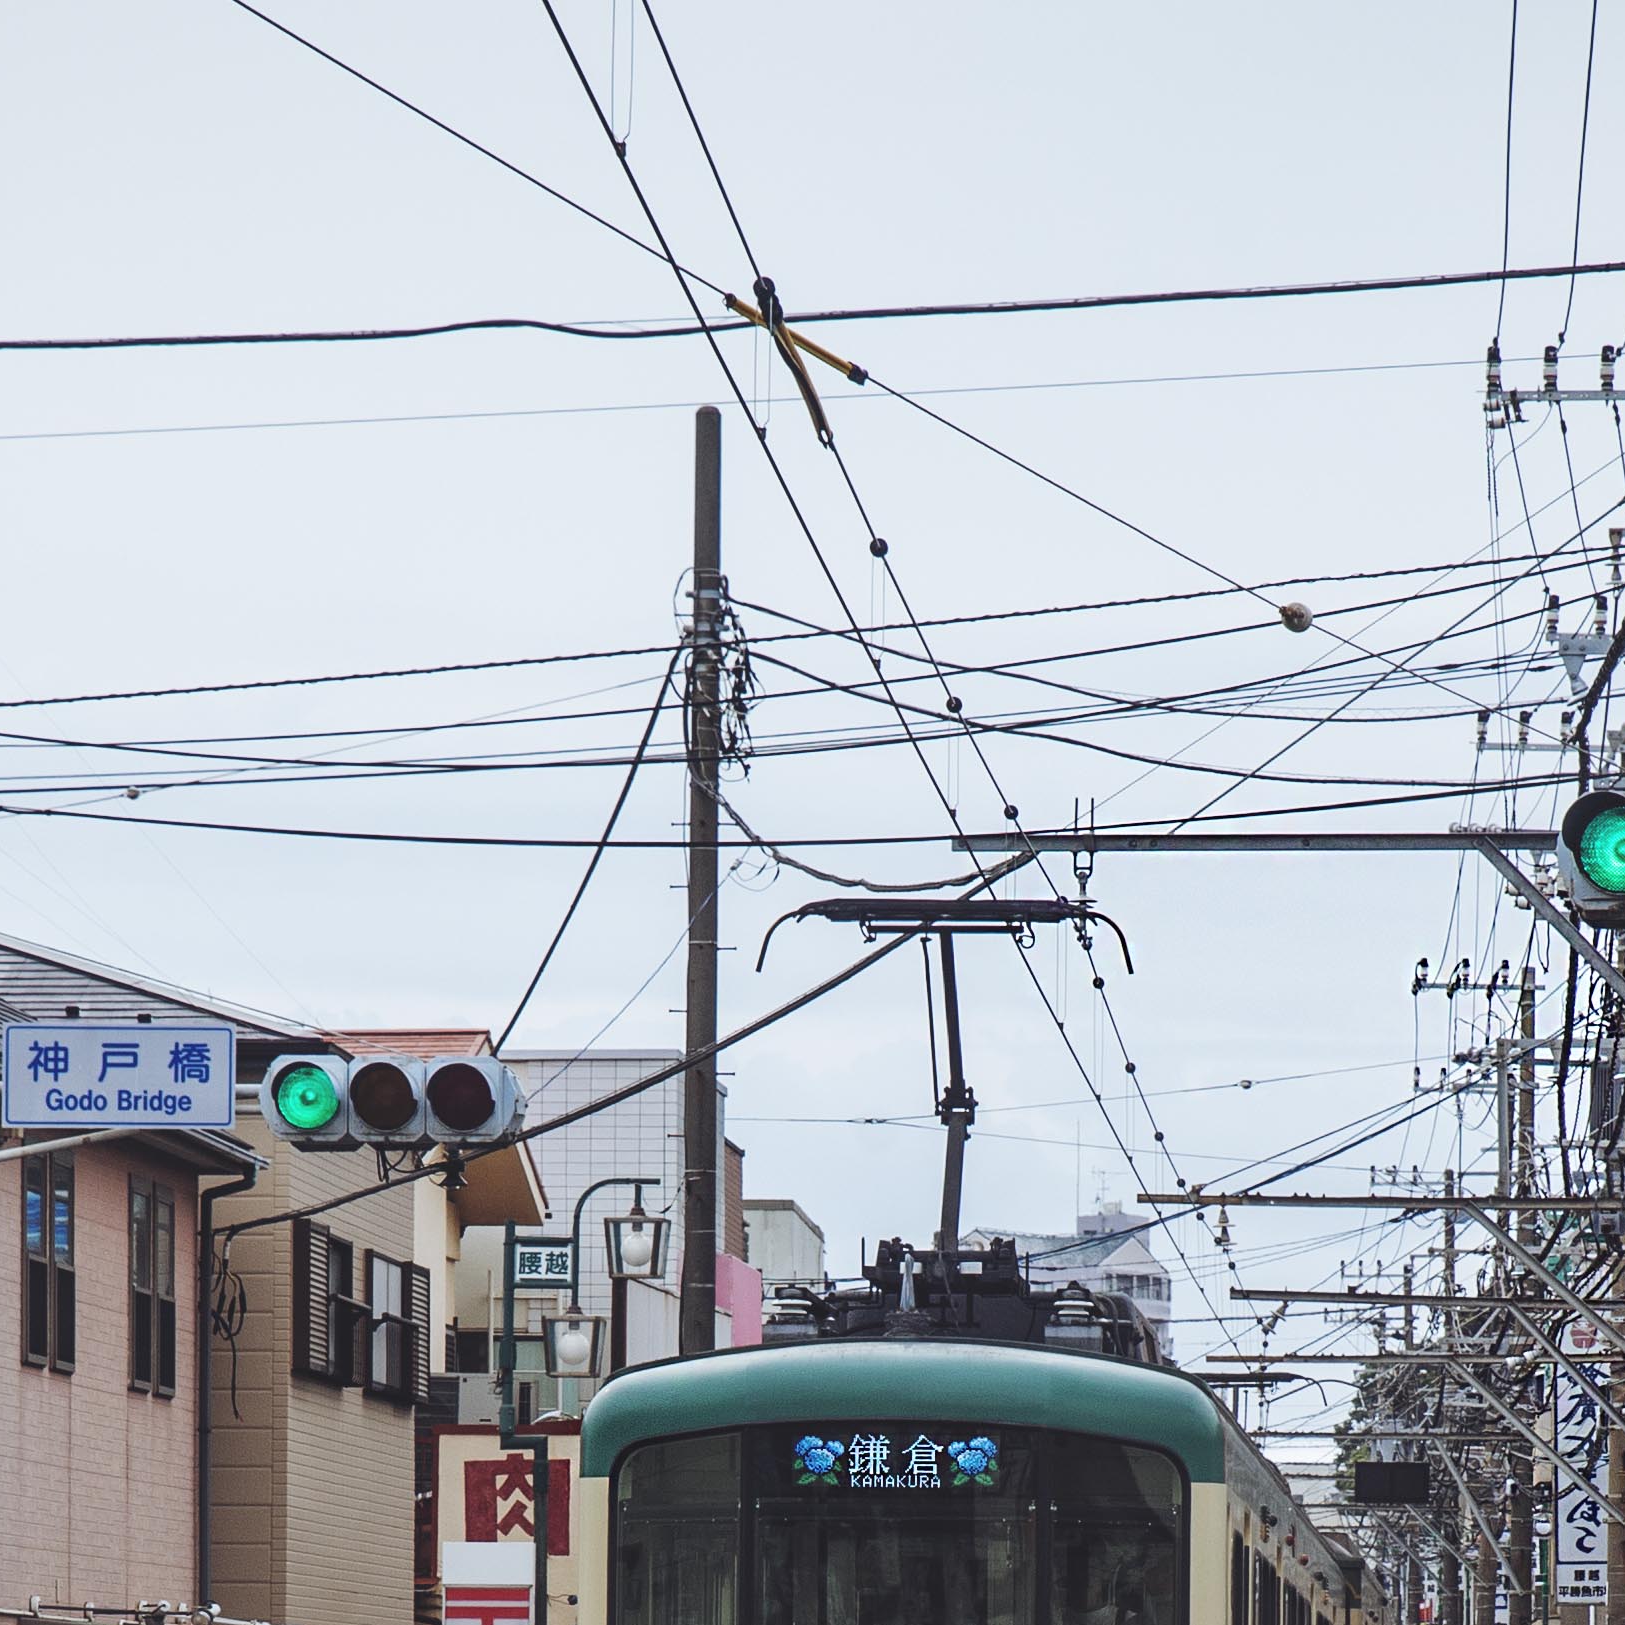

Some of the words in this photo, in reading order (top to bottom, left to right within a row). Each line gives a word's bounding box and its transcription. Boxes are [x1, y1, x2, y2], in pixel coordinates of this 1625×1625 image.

[27, 1040, 212, 1084] 神戸橋
[45, 1088, 108, 1112] Godo
[117, 1088, 193, 1116] Bridge
[518, 1249, 570, 1278] 腰越
[848, 1434, 945, 1475] 鎌倉
[850, 1474, 942, 1489] KAMAKURA
